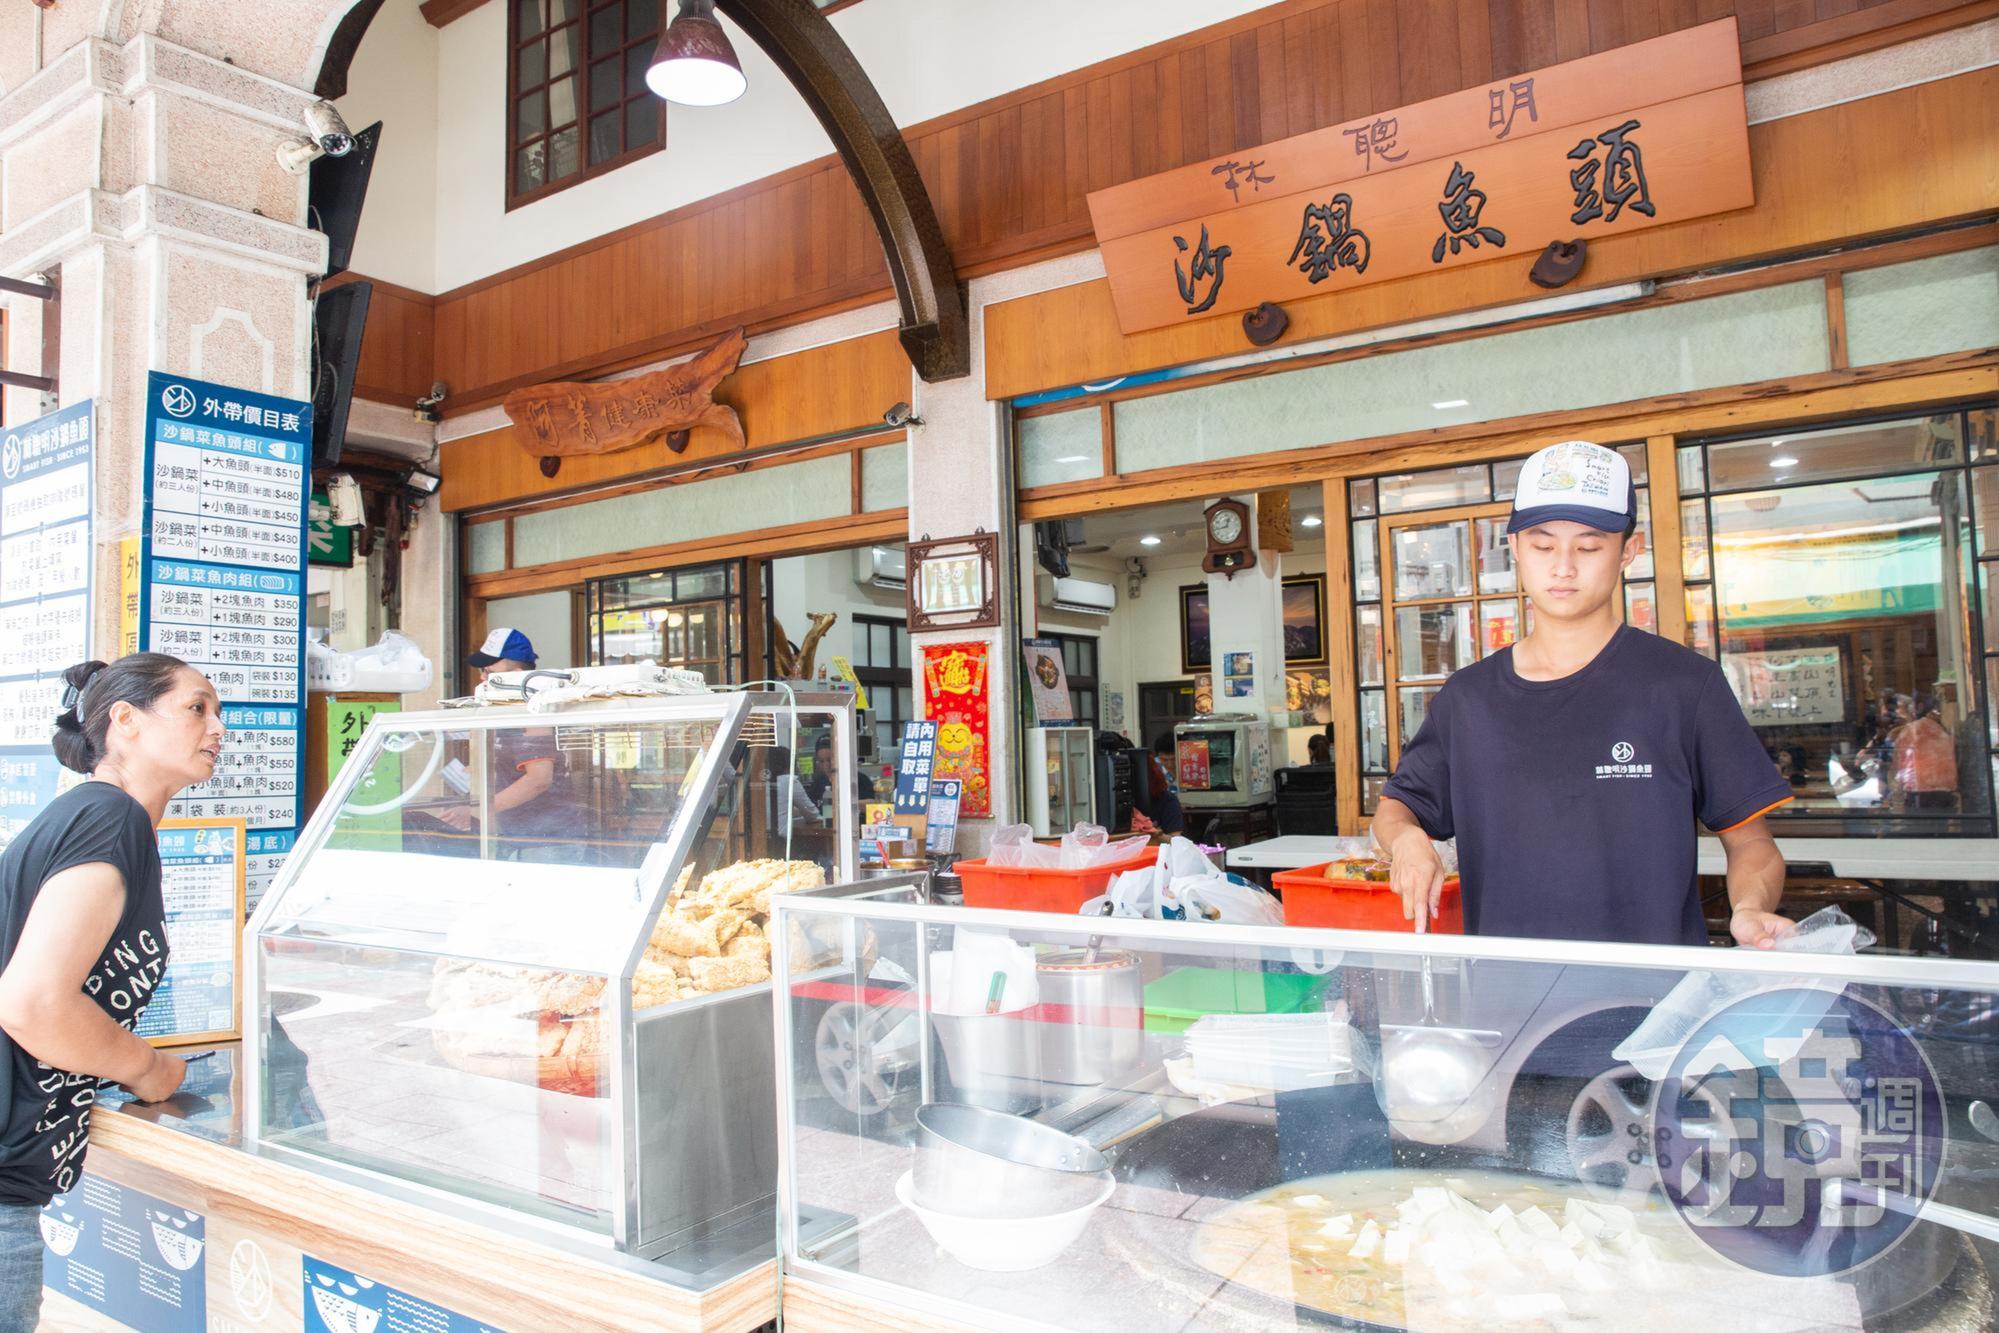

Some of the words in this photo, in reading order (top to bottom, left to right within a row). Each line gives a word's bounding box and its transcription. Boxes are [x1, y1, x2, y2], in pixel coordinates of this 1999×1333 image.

[1211, 77, 1538, 203] 林聰明
[1172, 119, 1657, 314] 沙鍋魚頭
[202, 397, 300, 433] 外帶價目表
[157, 464, 199, 482] 沙鍋菜
[275, 467, 300, 480] $510
[275, 490, 299, 501] $480
[274, 510, 299, 522] $450
[155, 521, 197, 538] 沙鍋菜
[274, 532, 298, 544] $430
[273, 553, 298, 565] $400
[161, 590, 203, 606] 沙鍋菜
[214, 593, 265, 608] +2塊魚肉
[273, 599, 298, 610] $350
[213, 612, 265, 626] +1塊魚肉
[273, 616, 297, 627] $290
[160, 629, 202, 644] 沙鍋菜
[213, 631, 265, 646] +2塊魚肉
[273, 635, 297, 645] $300
[213, 650, 265, 663] +1塊魚肉
[273, 653, 296, 663] $240
[273, 671, 296, 681] $130
[217, 687, 232, 697] 份)
[273, 689, 296, 698] $135
[221, 732, 268, 745] 頭+魚肉
[269, 737, 295, 746] $580
[901, 723, 920, 775] 請自取
[269, 759, 294, 769] $550
[913, 722, 934, 793] 內用菜單
[269, 781, 294, 791] $520
[268, 808, 293, 819] $240
